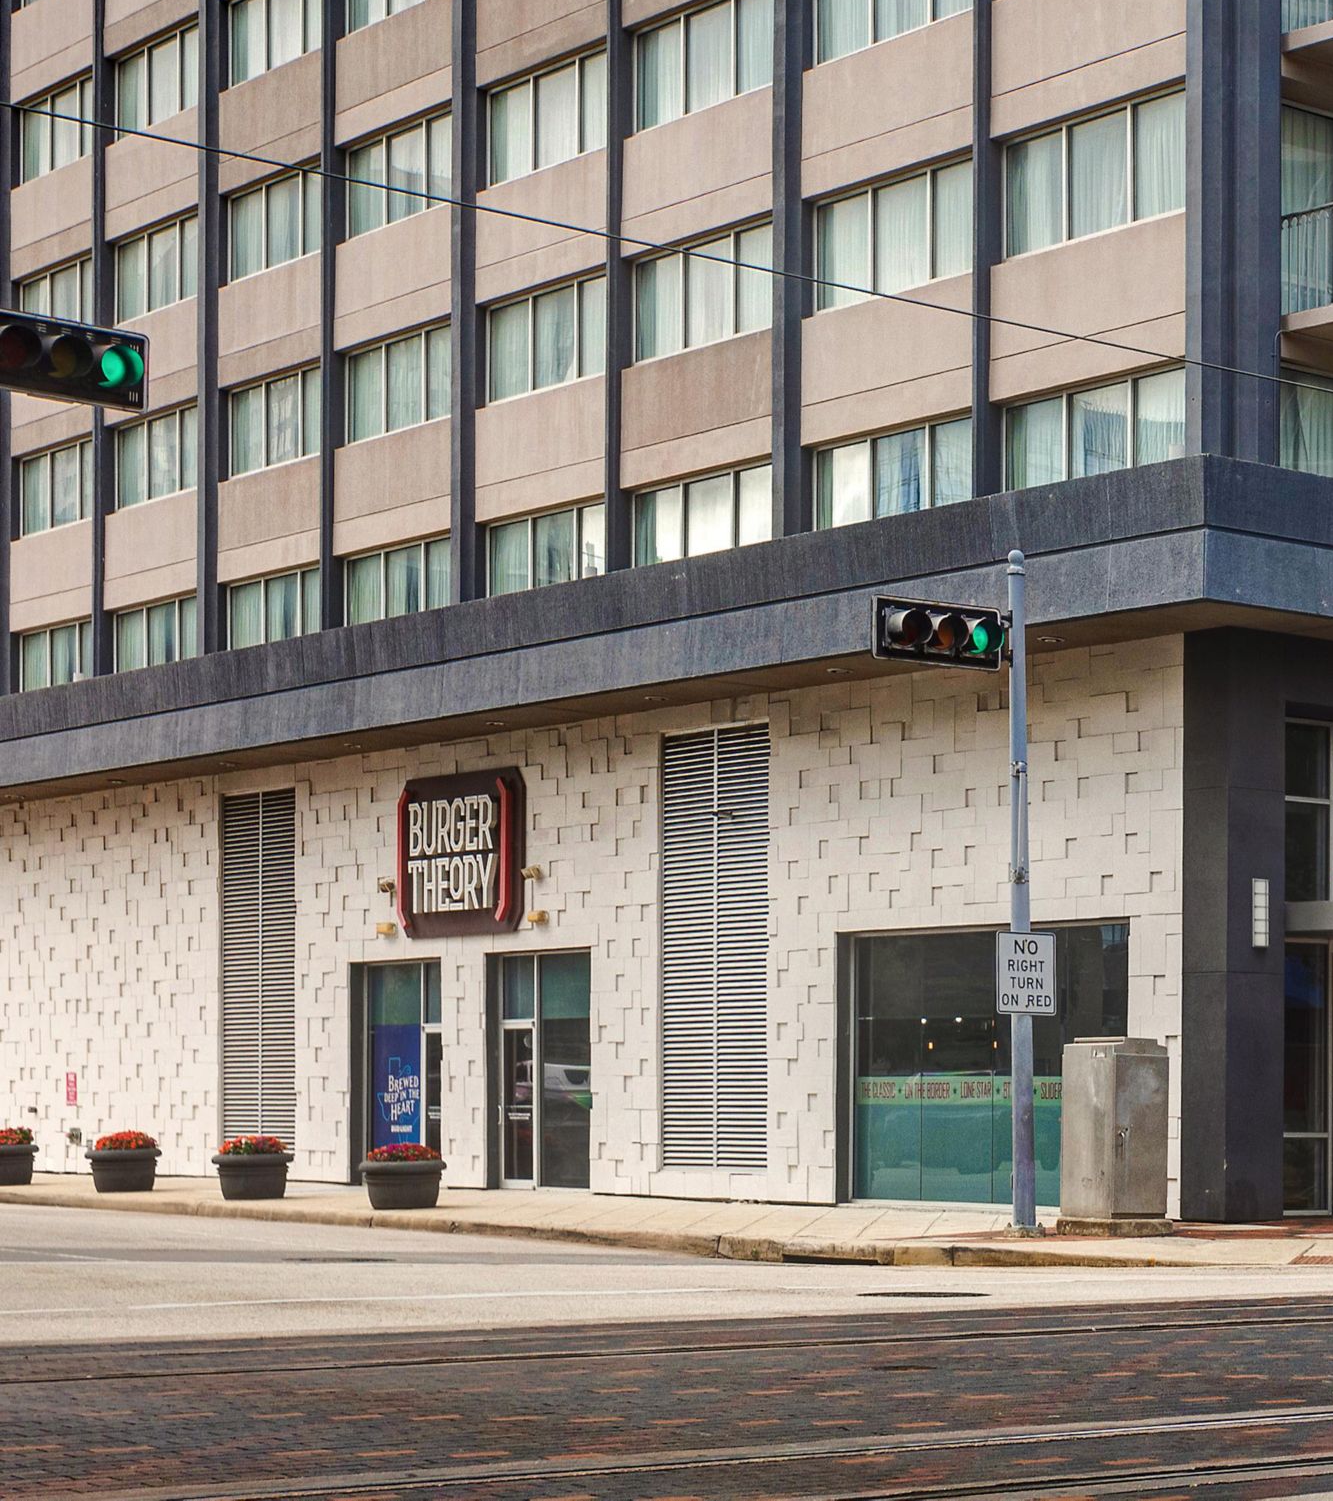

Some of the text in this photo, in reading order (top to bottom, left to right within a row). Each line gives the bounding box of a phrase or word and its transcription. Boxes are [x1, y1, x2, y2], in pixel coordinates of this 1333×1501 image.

[408, 794, 497, 857] BURGER
[408, 853, 498, 914] THEORY
[1014, 939, 1038, 955] NO
[1008, 959, 1045, 973] RIGHT
[1010, 976, 1043, 990] TURN
[1001, 993, 1052, 1007] ON RED
[388, 1074, 419, 1093] BREWED
[861, 1082, 871, 1099] THE
[872, 1082, 896, 1099] CLASSIC
[927, 1082, 950, 1100] BORDER
[960, 1081, 975, 1099] LONE
[976, 1081, 992, 1099] STAR
[384, 1088, 420, 1103] DEEP IN THE
[390, 1100, 415, 1121] HEART
